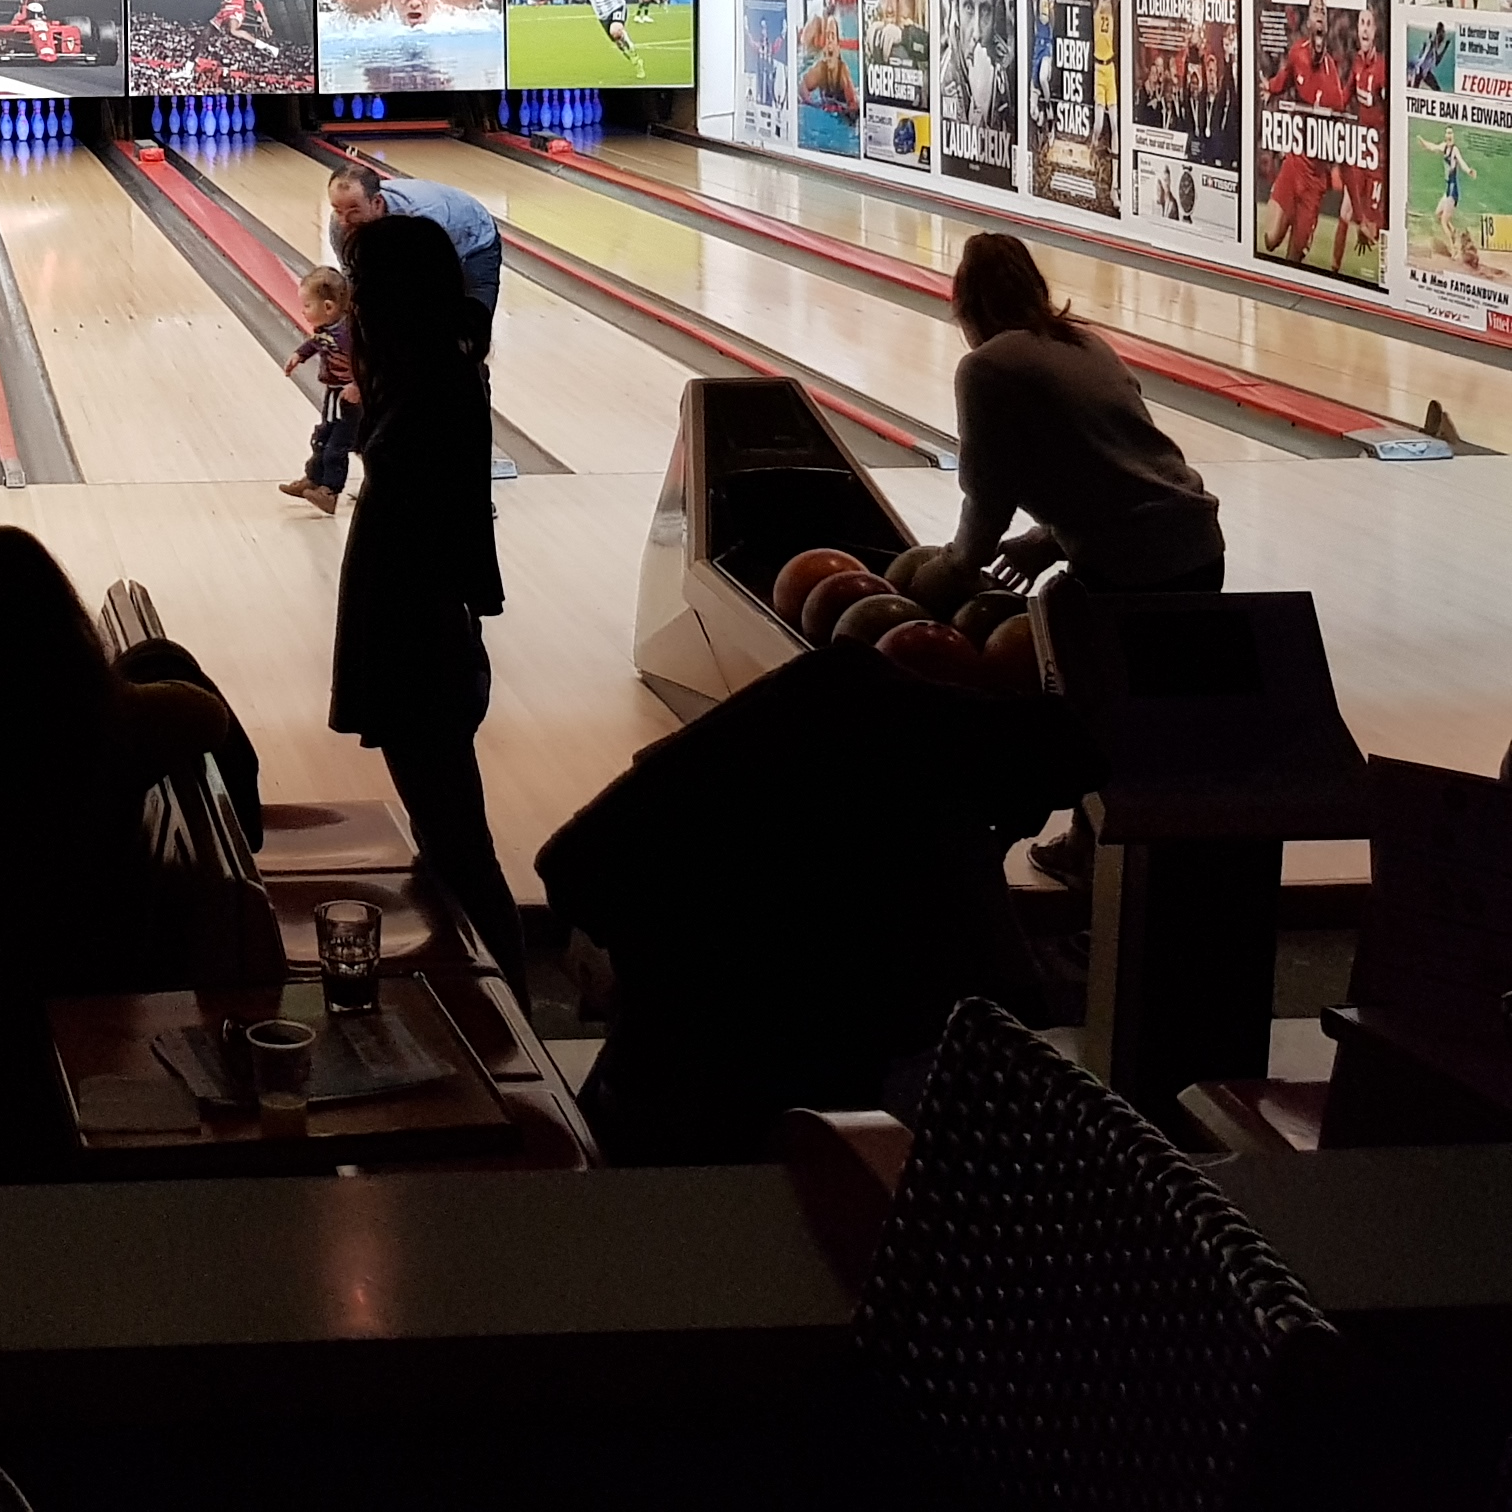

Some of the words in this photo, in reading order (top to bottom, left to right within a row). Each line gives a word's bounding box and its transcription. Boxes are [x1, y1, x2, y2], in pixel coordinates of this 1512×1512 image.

[1067, 5, 1079, 38] LE
[1056, 38, 1090, 72] DERBY
[868, 64, 894, 98] OGIER
[1063, 70, 1083, 103] DES
[1056, 102, 1089, 137] STARS
[1406, 97, 1436, 116] TRIPLE
[1439, 101, 1459, 120] BAN
[1461, 105, 1468, 121] A
[942, 120, 1011, 169] L'AUDACIEUX
[1262, 110, 1303, 156] REDS
[1306, 117, 1379, 170] DINGUES
[1422, 273, 1427, 283] &
